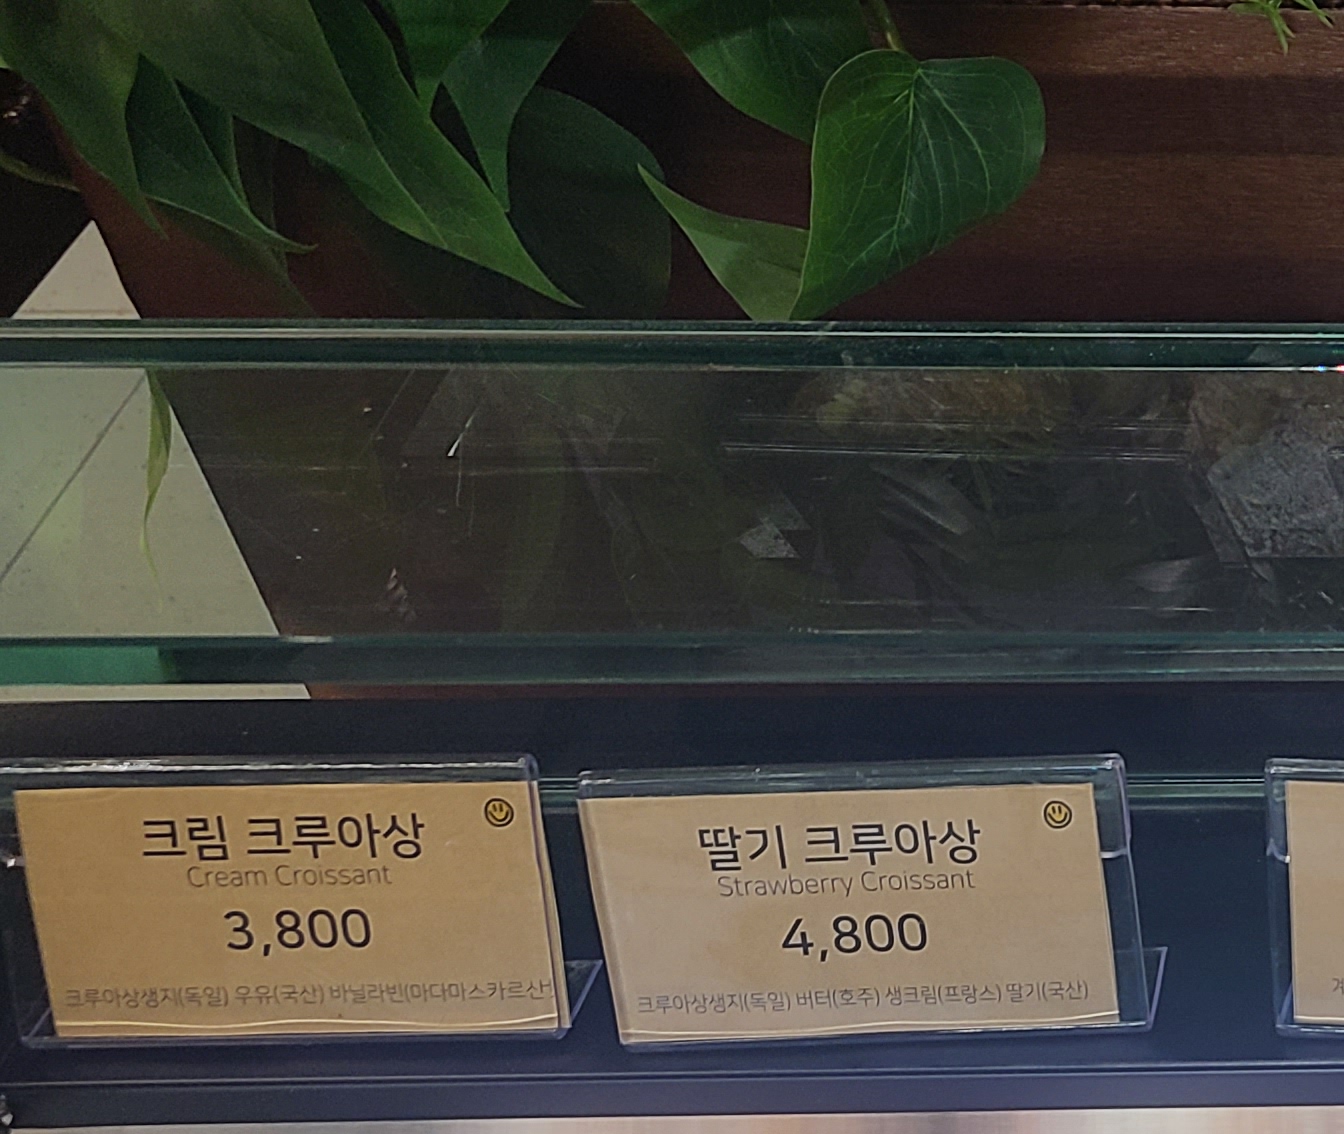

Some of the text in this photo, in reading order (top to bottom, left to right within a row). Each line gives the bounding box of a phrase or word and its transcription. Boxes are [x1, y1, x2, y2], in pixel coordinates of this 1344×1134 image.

[142, 812, 425, 860] 크림 크루아상
[699, 820, 981, 871] 딸기 크루아상
[186, 864, 392, 888] Cream Croissant
[718, 869, 976, 898] Strawberry Croissant
[226, 909, 372, 956] 3,800
[781, 913, 927, 962] 4,800
[66, 986, 229, 1009] 크루아상생지(독일)
[234, 983, 325, 1005] 우유(국산)
[638, 980, 1088, 1014] 크루아상생지(독일) 버터(호주) 생크림(프랑스) 딸기(국산)
